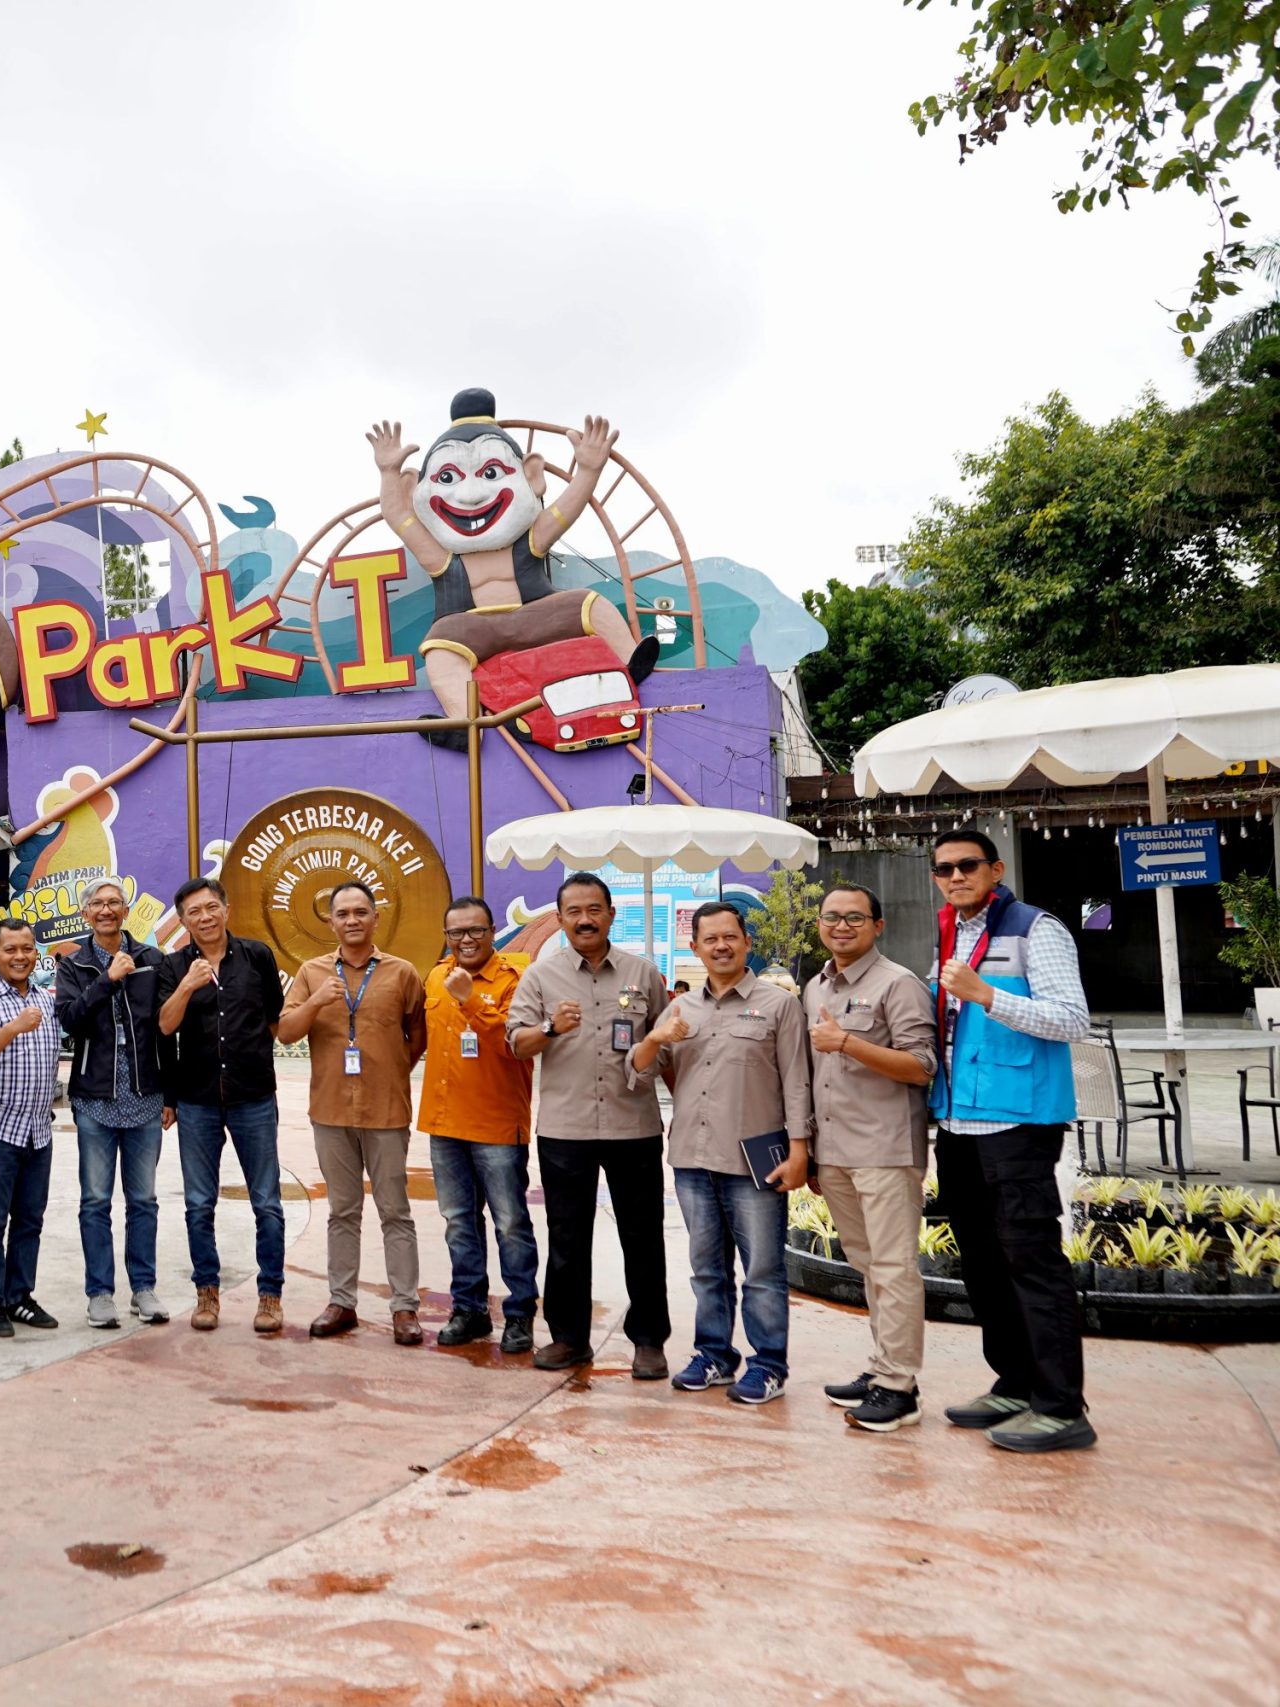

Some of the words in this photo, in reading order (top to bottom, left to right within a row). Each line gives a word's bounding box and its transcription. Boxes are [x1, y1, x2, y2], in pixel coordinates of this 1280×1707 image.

[12, 569, 303, 724] Park
[240, 824, 285, 872] GONG
[280, 805, 384, 841] TERBESAR
[380, 829, 414, 862] KE
[1123, 829, 1182, 841] PEMBELIAN
[1185, 827, 1214, 838] TIKET
[1137, 839, 1203, 852] ROMBONGAN
[33, 870, 70, 890] JATIM
[74, 866, 105, 880] PARK
[272, 870, 300, 911] JAWA
[293, 849, 342, 874] TIMUR
[346, 854, 385, 896] PARK
[1136, 872, 1169, 883] PINTU
[1171, 870, 1208, 881] MASUK
[42, 924, 83, 940] LIBURAN
